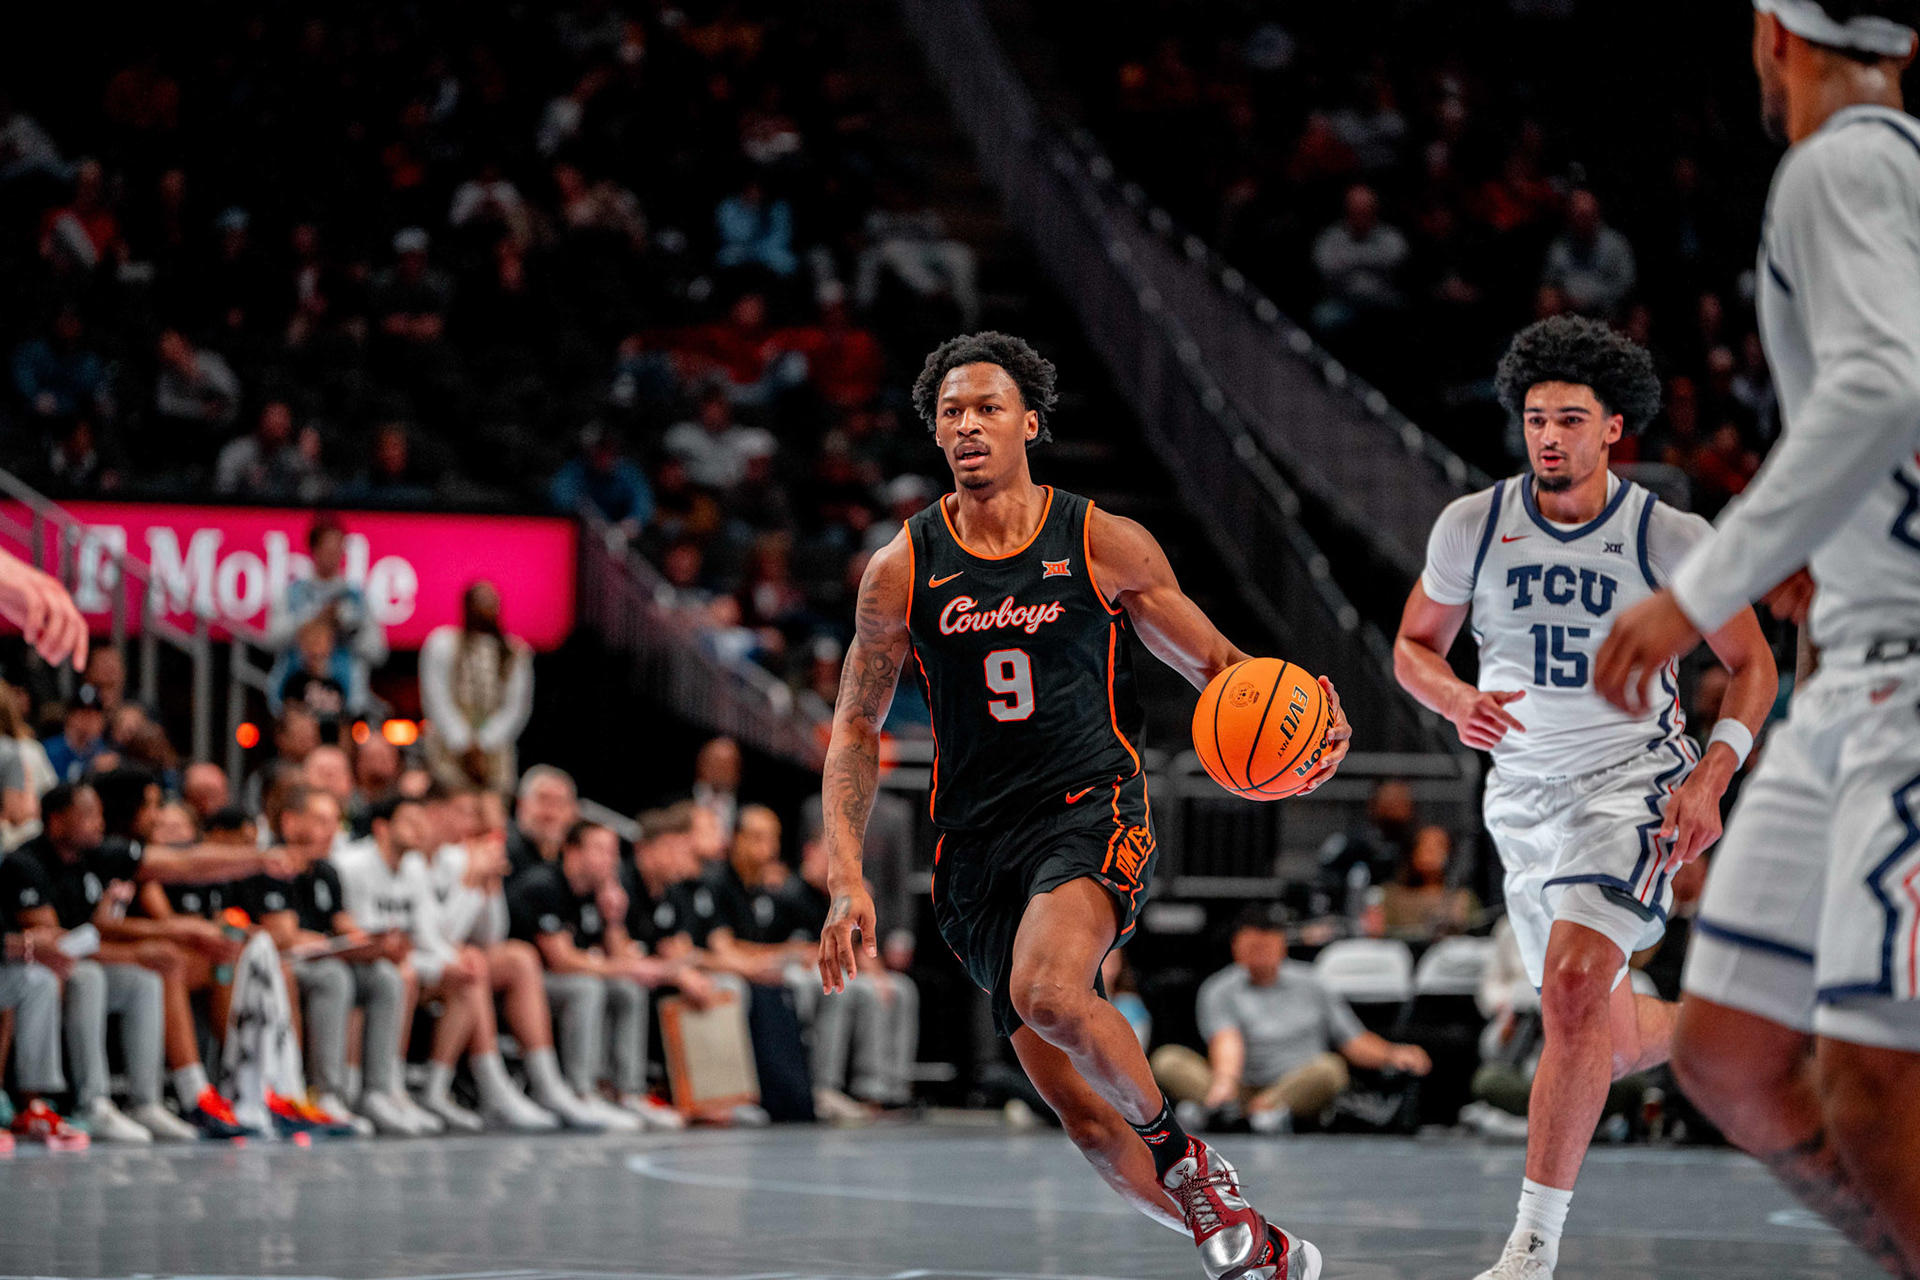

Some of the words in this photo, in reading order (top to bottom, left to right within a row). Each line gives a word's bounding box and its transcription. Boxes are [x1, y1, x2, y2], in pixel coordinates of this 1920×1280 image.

[1042, 558, 1072, 579] XII
[1602, 541, 1624, 555] XII
[144, 526, 418, 627] Moble
[1507, 564, 1618, 618] TCU
[939, 595, 1065, 636] Cowboys
[1529, 623, 1590, 688] 15
[983, 648, 1035, 722] 9
[1280, 685, 1309, 741] EVO
[1277, 739, 1289, 758] NXT
